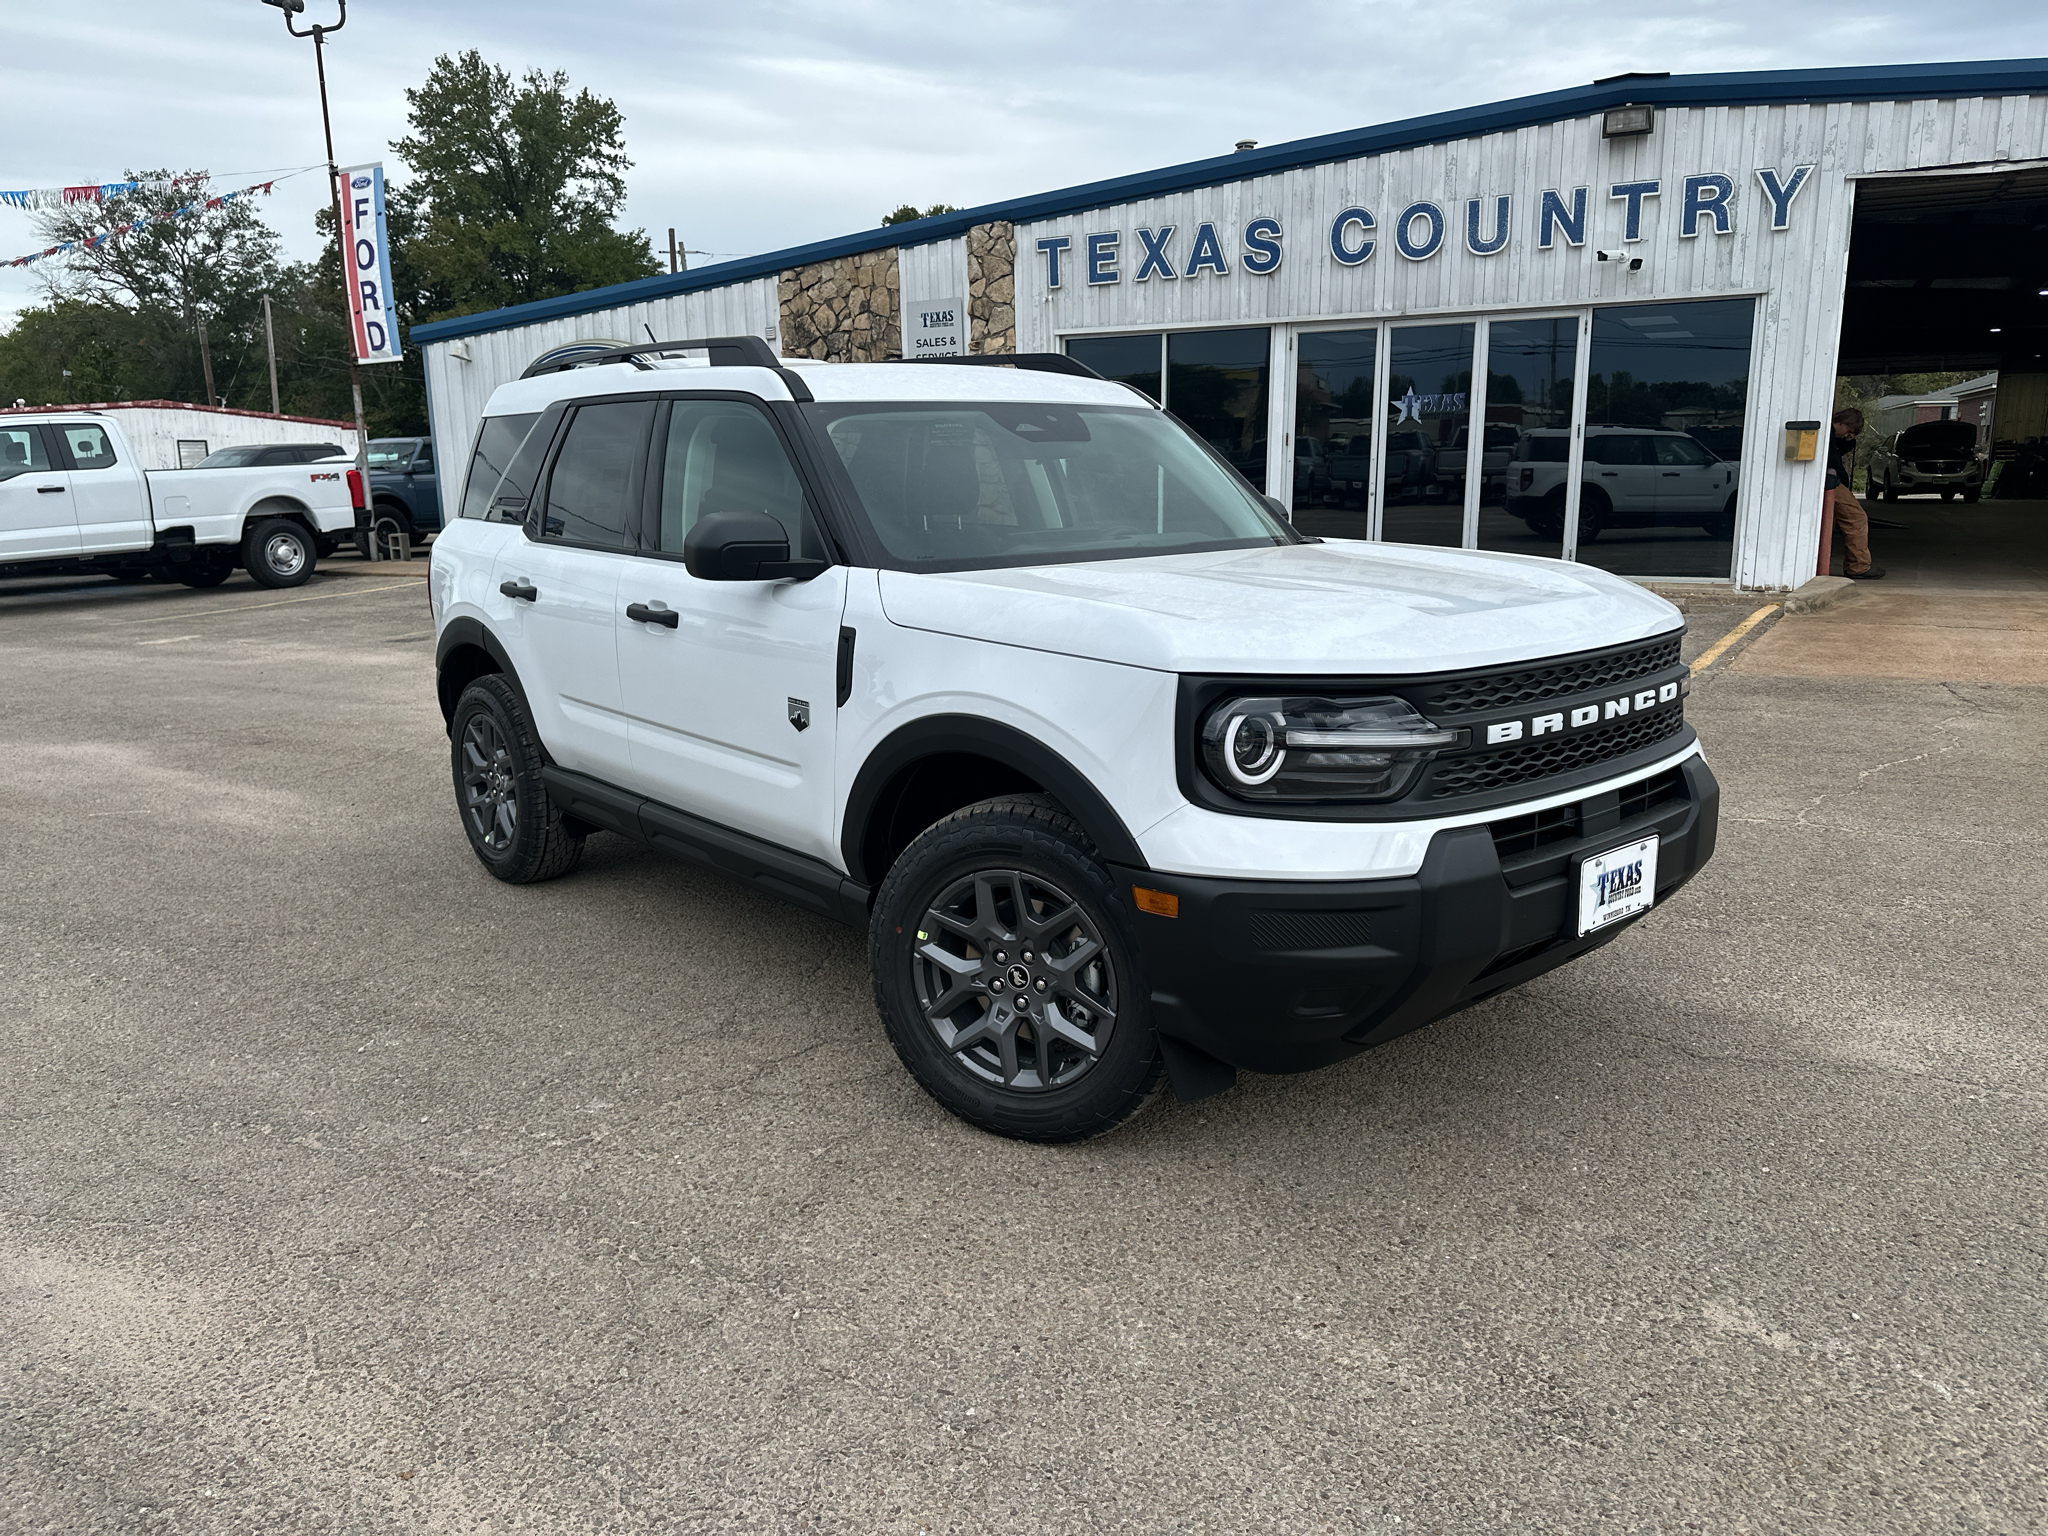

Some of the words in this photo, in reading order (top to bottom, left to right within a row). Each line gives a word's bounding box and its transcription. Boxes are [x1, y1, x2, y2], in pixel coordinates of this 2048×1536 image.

[1035, 215, 1284, 290] TEXAS
[1329, 163, 1818, 268] COUNTRY
[354, 197, 386, 352] FORD
[920, 309, 954, 328] TEXAS
[915, 336, 947, 348] SALES
[949, 336, 957, 346] &
[1401, 392, 1466, 417] TEXAS
[310, 472, 340, 482] FX4
[1486, 681, 1678, 745] BRONCO
[1597, 859, 1643, 907] TEXAS
